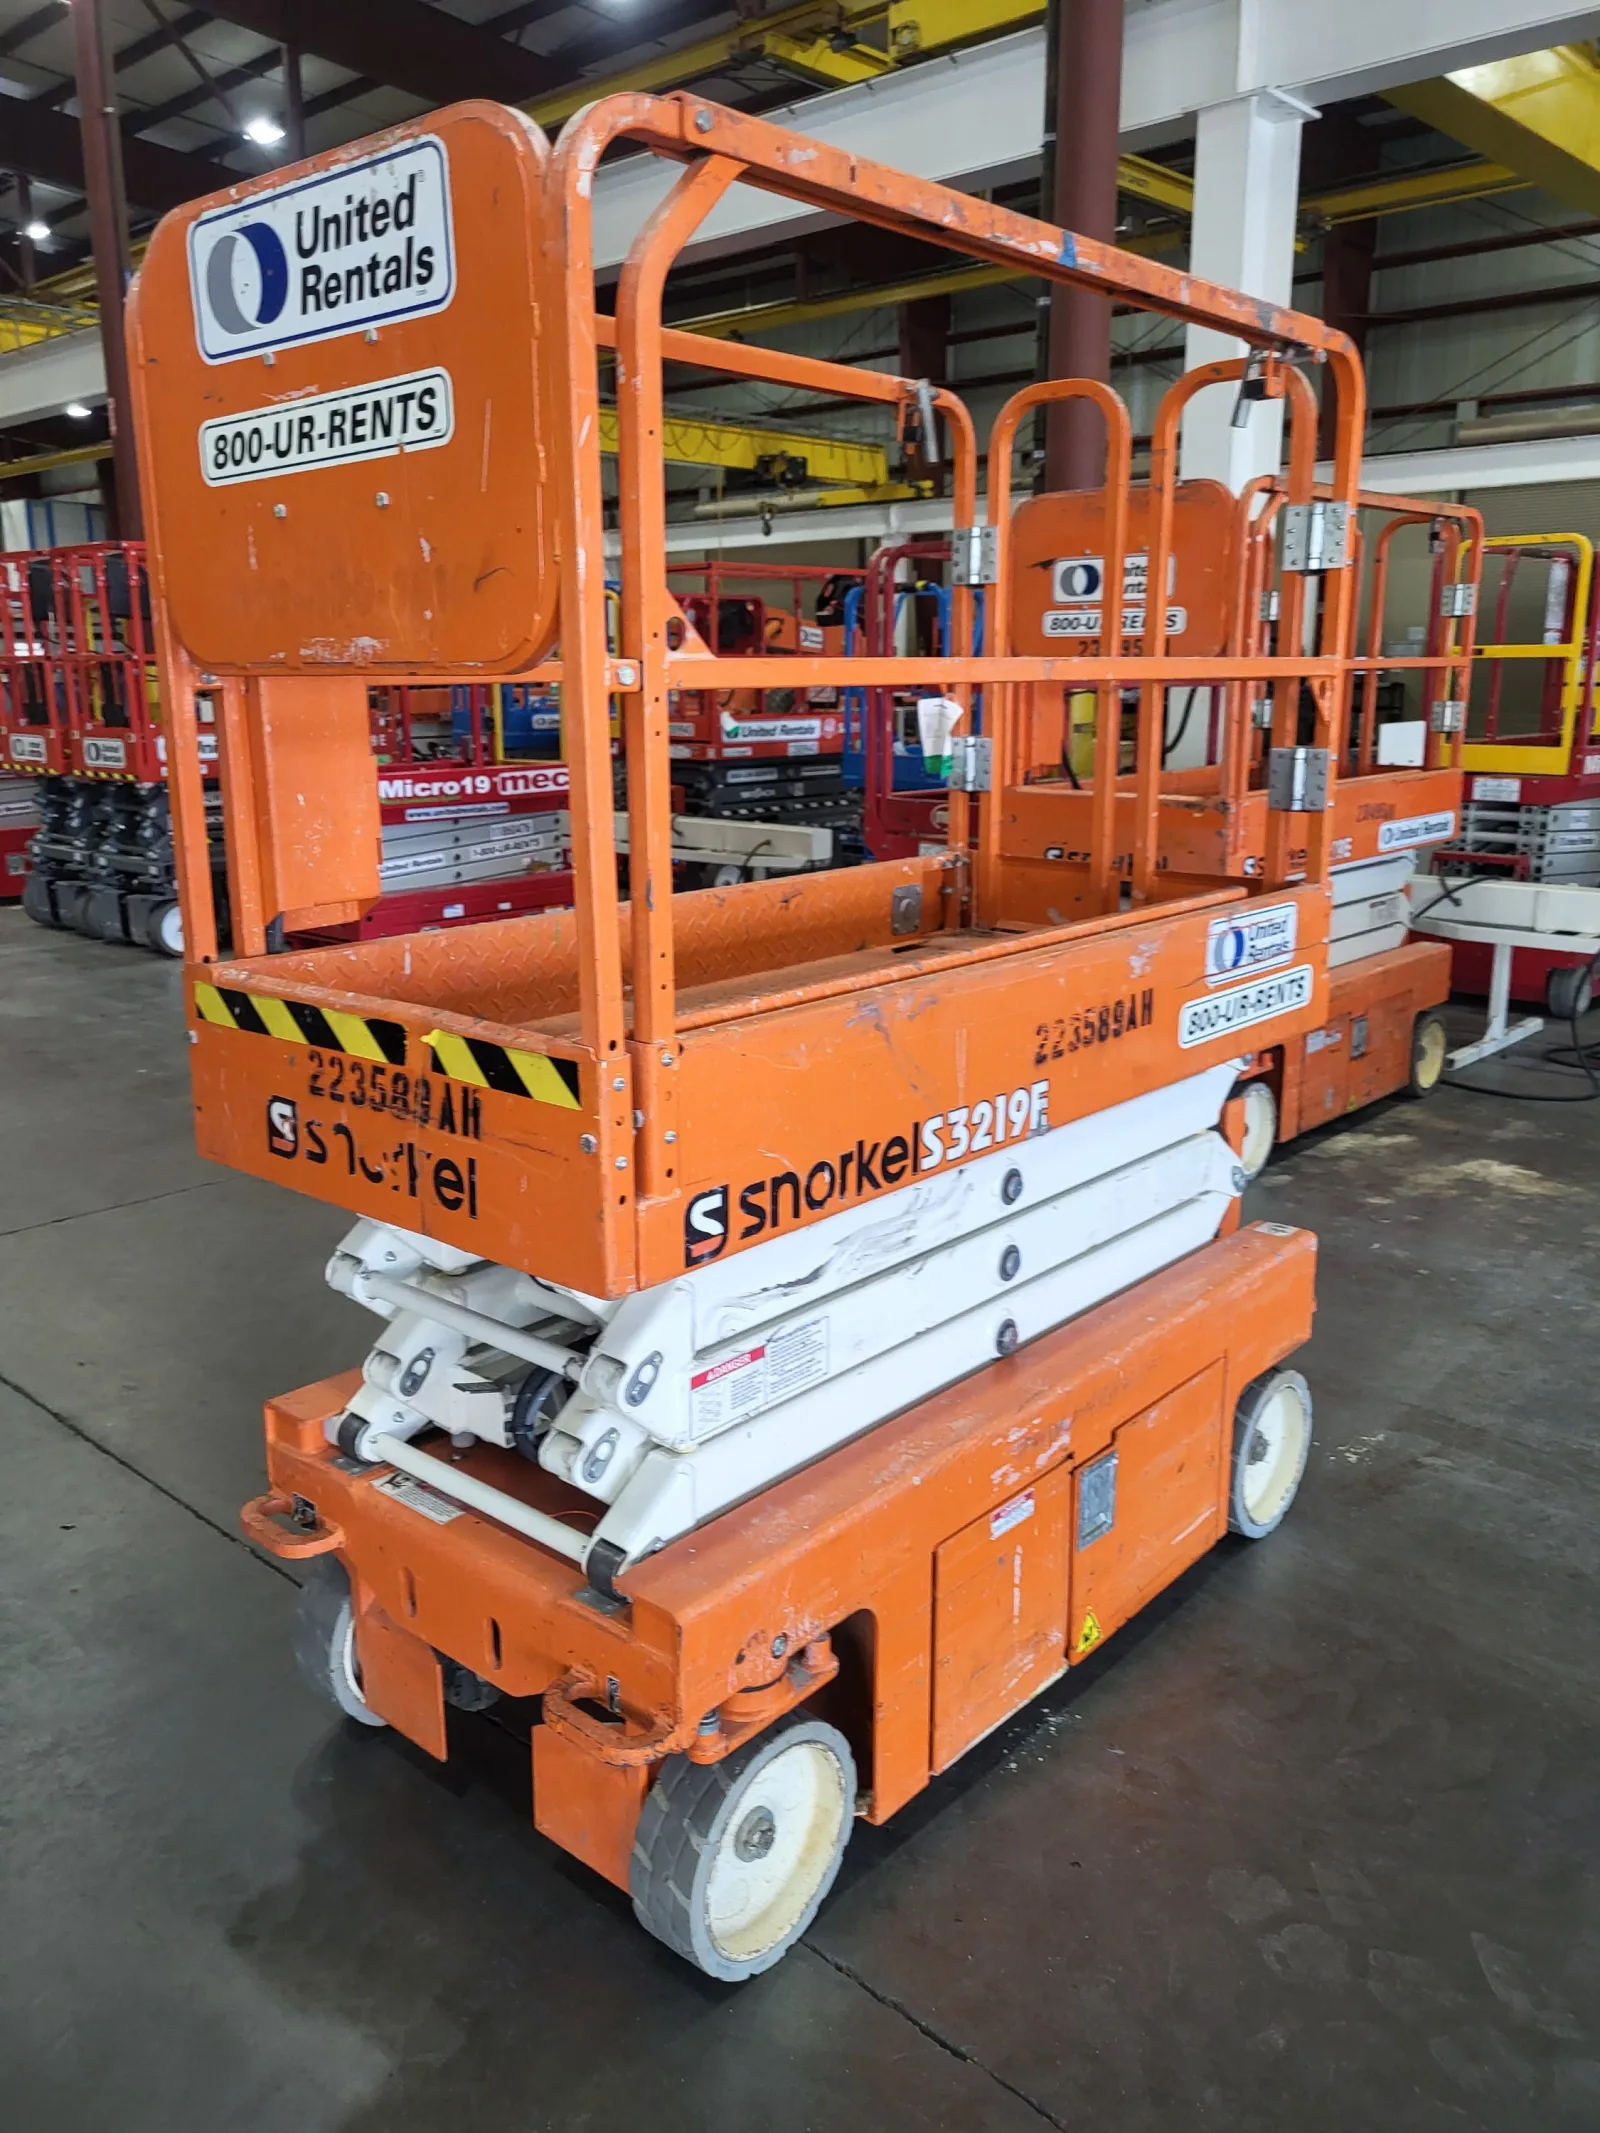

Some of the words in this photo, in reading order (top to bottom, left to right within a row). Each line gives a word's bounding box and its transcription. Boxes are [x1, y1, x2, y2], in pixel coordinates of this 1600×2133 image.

[296, 173, 414, 259] United
[301, 236, 434, 315] Rentals
[213, 387, 437, 470] 800-UR-RENTS
[378, 775, 491, 799] Micro19
[1249, 919, 1288, 942] United
[1249, 940, 1290, 963] Rentals
[1033, 988, 1155, 1066] 223589AH
[1187, 976, 1305, 1036] 800-UR-RENTS
[738, 1121, 919, 1240] snorkel
